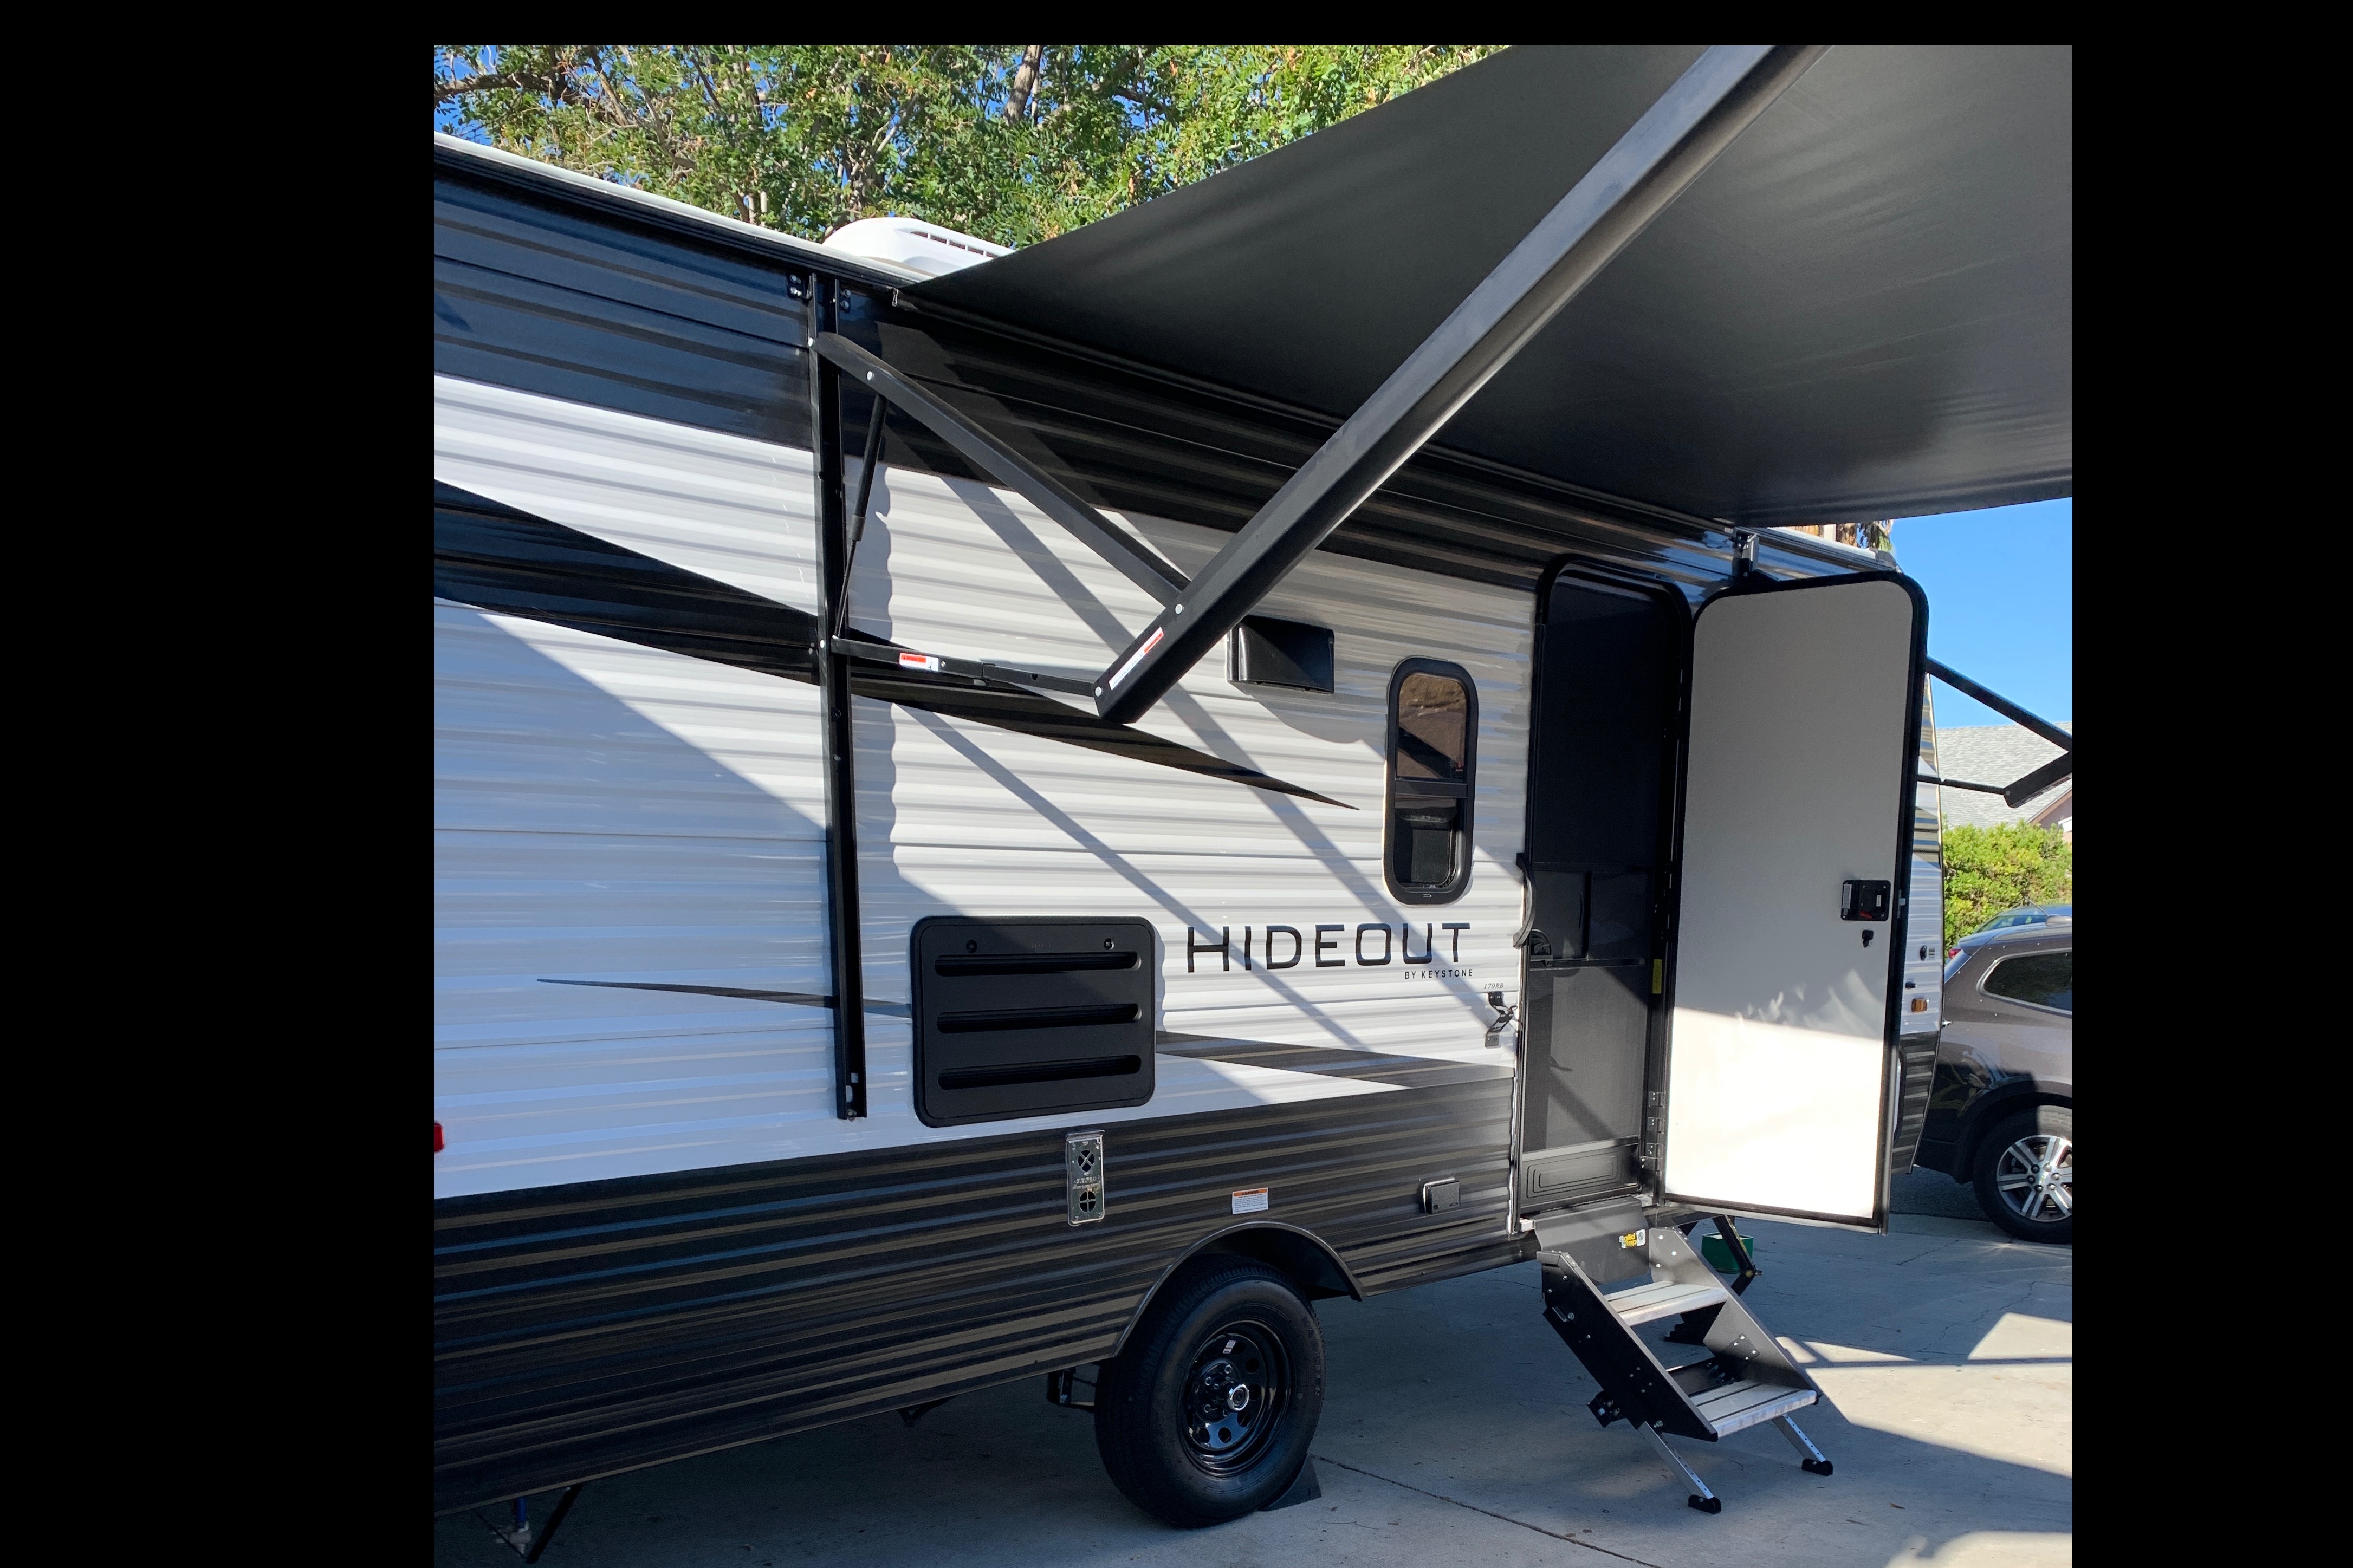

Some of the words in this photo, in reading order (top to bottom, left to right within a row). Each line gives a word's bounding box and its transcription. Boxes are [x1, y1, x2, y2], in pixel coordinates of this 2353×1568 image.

[1187, 922, 1470, 973] HIDEOUT
[1404, 971, 1416, 979] BY
[1421, 969, 1473, 979] KEYSTONE
[1619, 1233, 1636, 1242] Solid
[1621, 1239, 1637, 1249] Step
